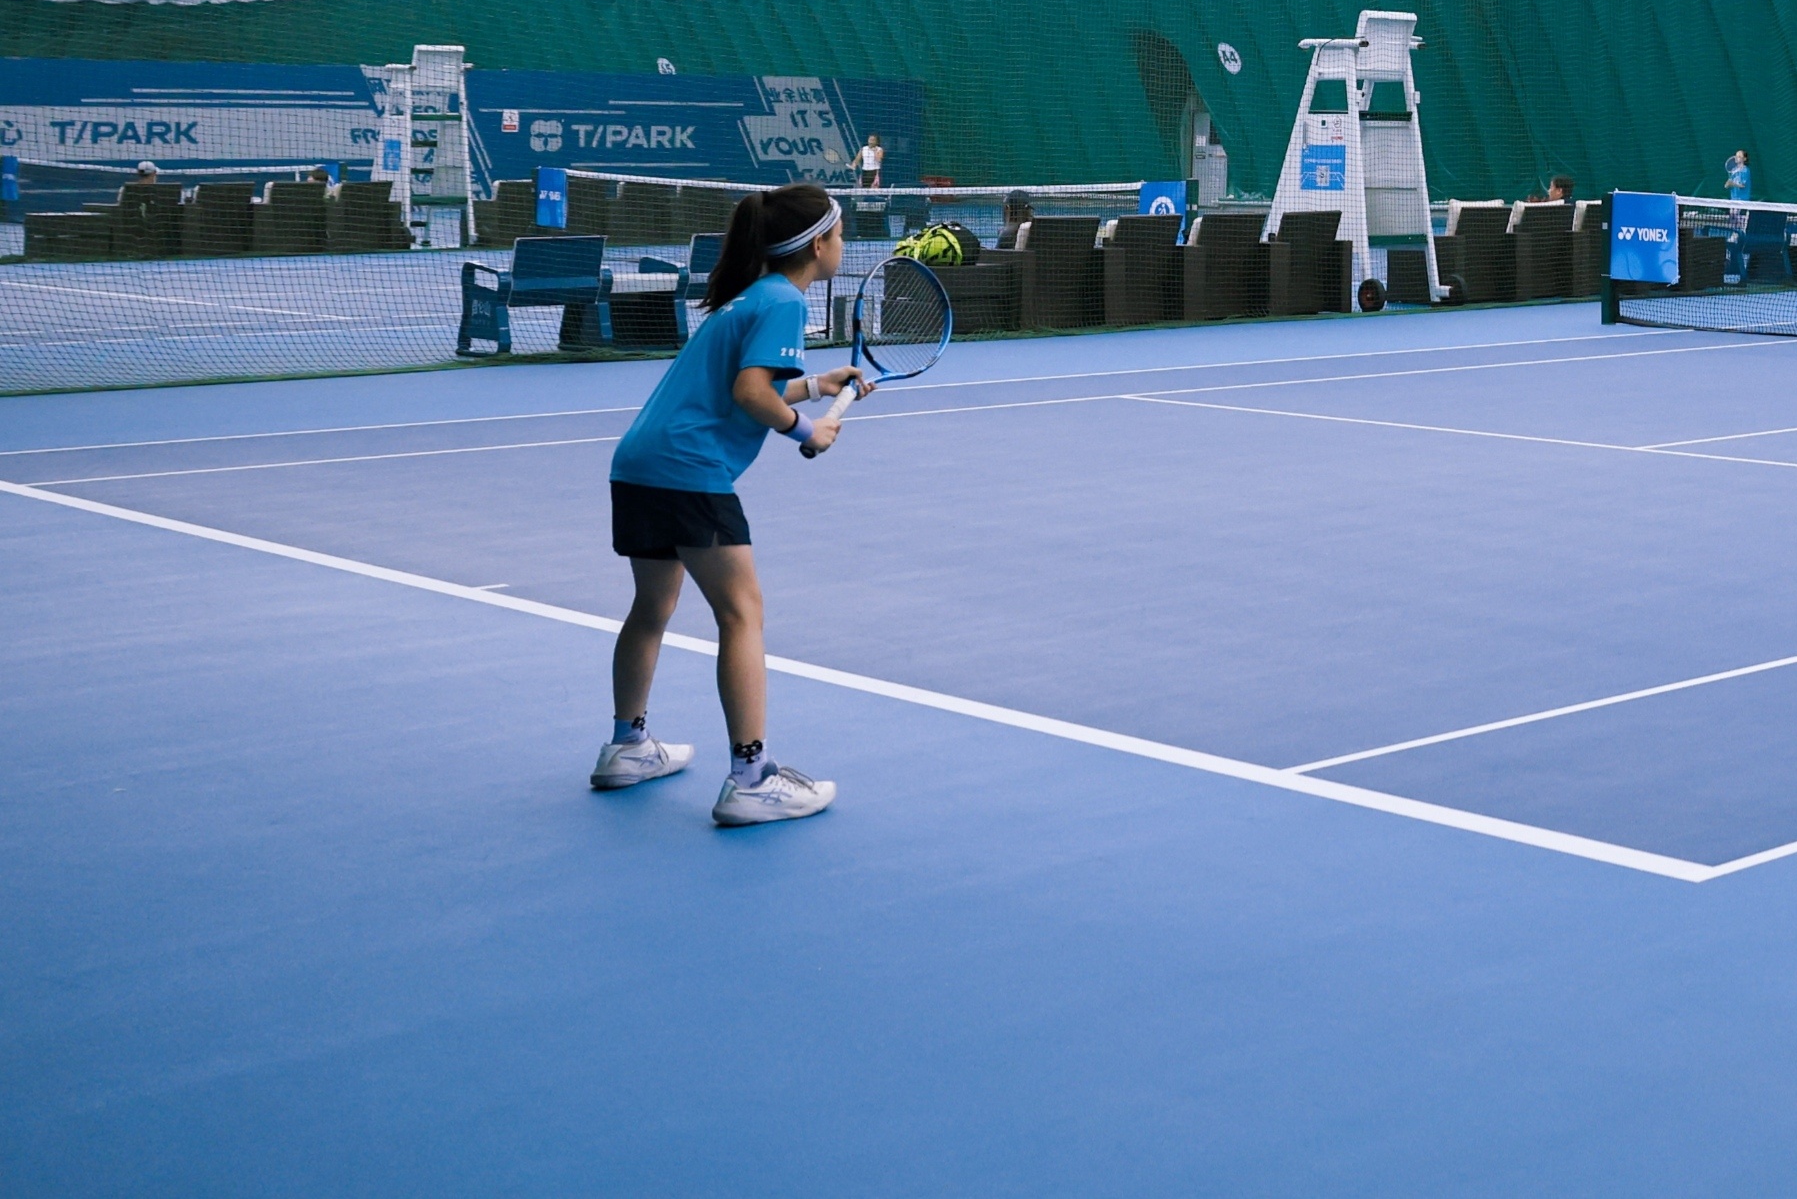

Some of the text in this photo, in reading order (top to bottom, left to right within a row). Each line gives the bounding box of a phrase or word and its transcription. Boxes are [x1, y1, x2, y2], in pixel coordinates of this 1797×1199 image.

[1221, 50, 1238, 64] A4
[50, 121, 199, 145] T/PARK
[571, 124, 696, 149] T/PARK
[759, 136, 824, 157] YOUR
[1637, 228, 1669, 242] YONEX
